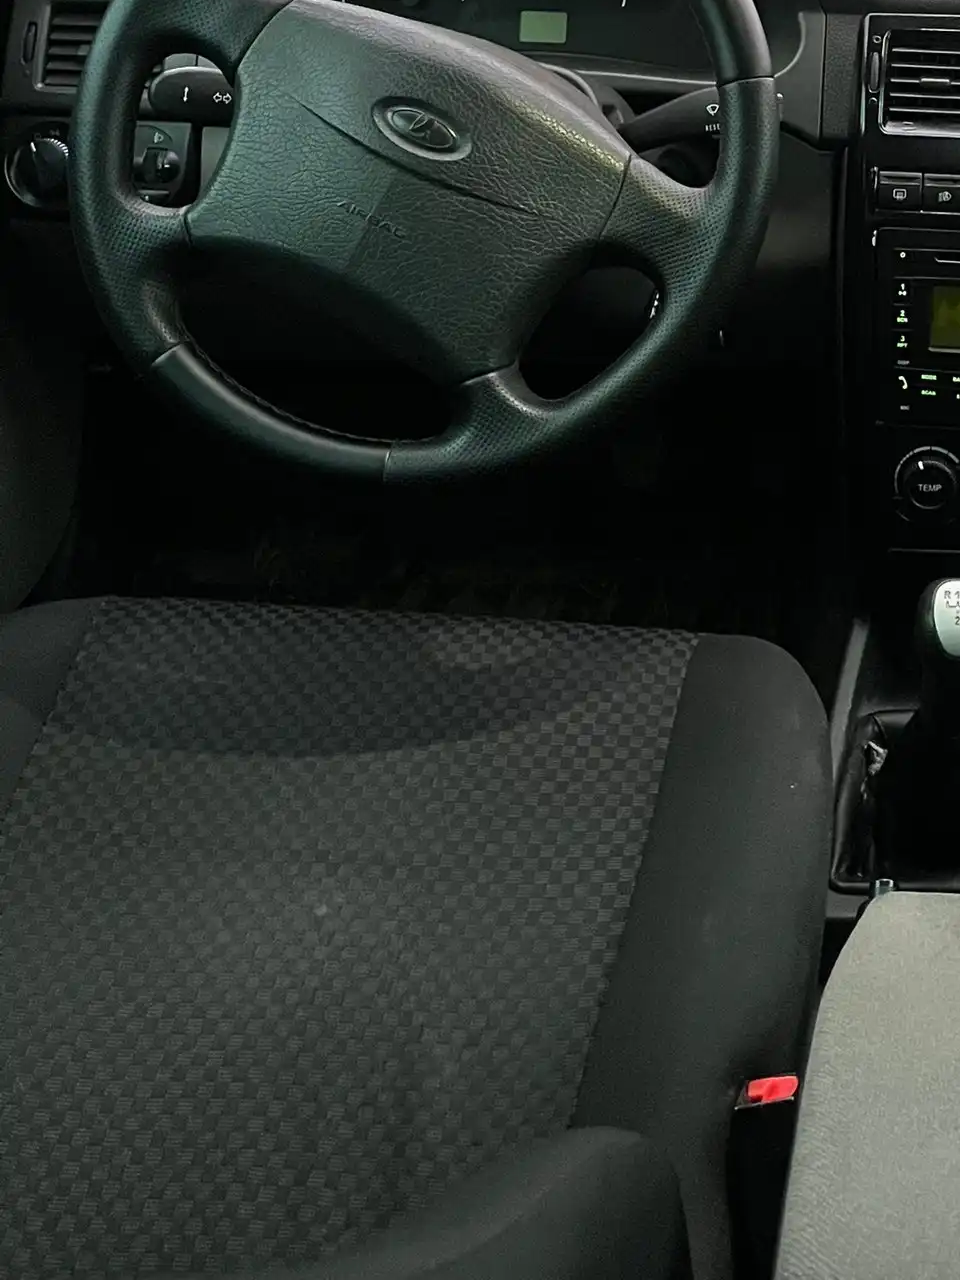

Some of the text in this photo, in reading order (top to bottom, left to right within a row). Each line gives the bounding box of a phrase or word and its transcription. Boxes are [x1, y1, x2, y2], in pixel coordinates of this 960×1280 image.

[918, 483, 943, 493] TEMP
[944, 590, 952, 600] R
[954, 591, 960, 599] 1
[954, 616, 960, 626] 2
